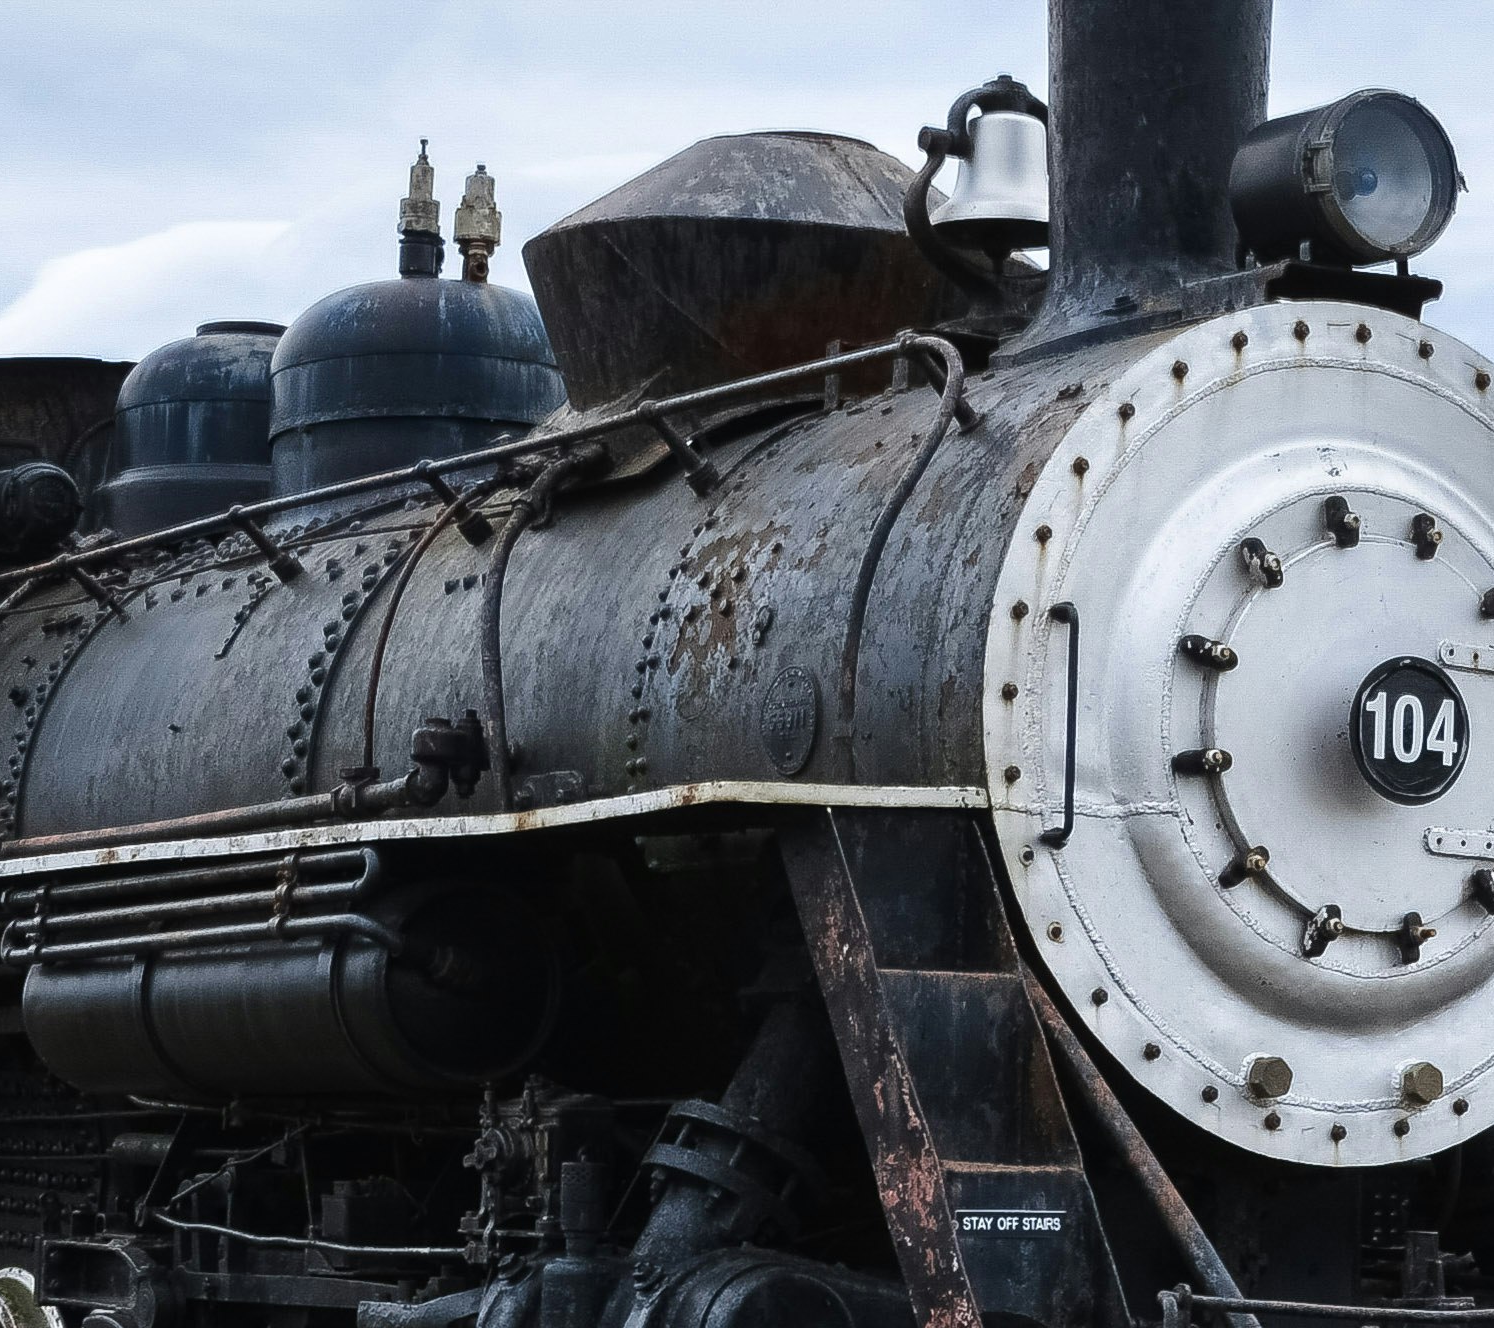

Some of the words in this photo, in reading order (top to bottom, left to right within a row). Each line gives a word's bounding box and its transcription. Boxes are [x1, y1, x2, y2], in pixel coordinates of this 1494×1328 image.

[1365, 691, 1458, 767] 104
[963, 1216, 994, 1231] STAY
[997, 1216, 1019, 1231] OFF
[1022, 1217, 1062, 1232] STAIRS
